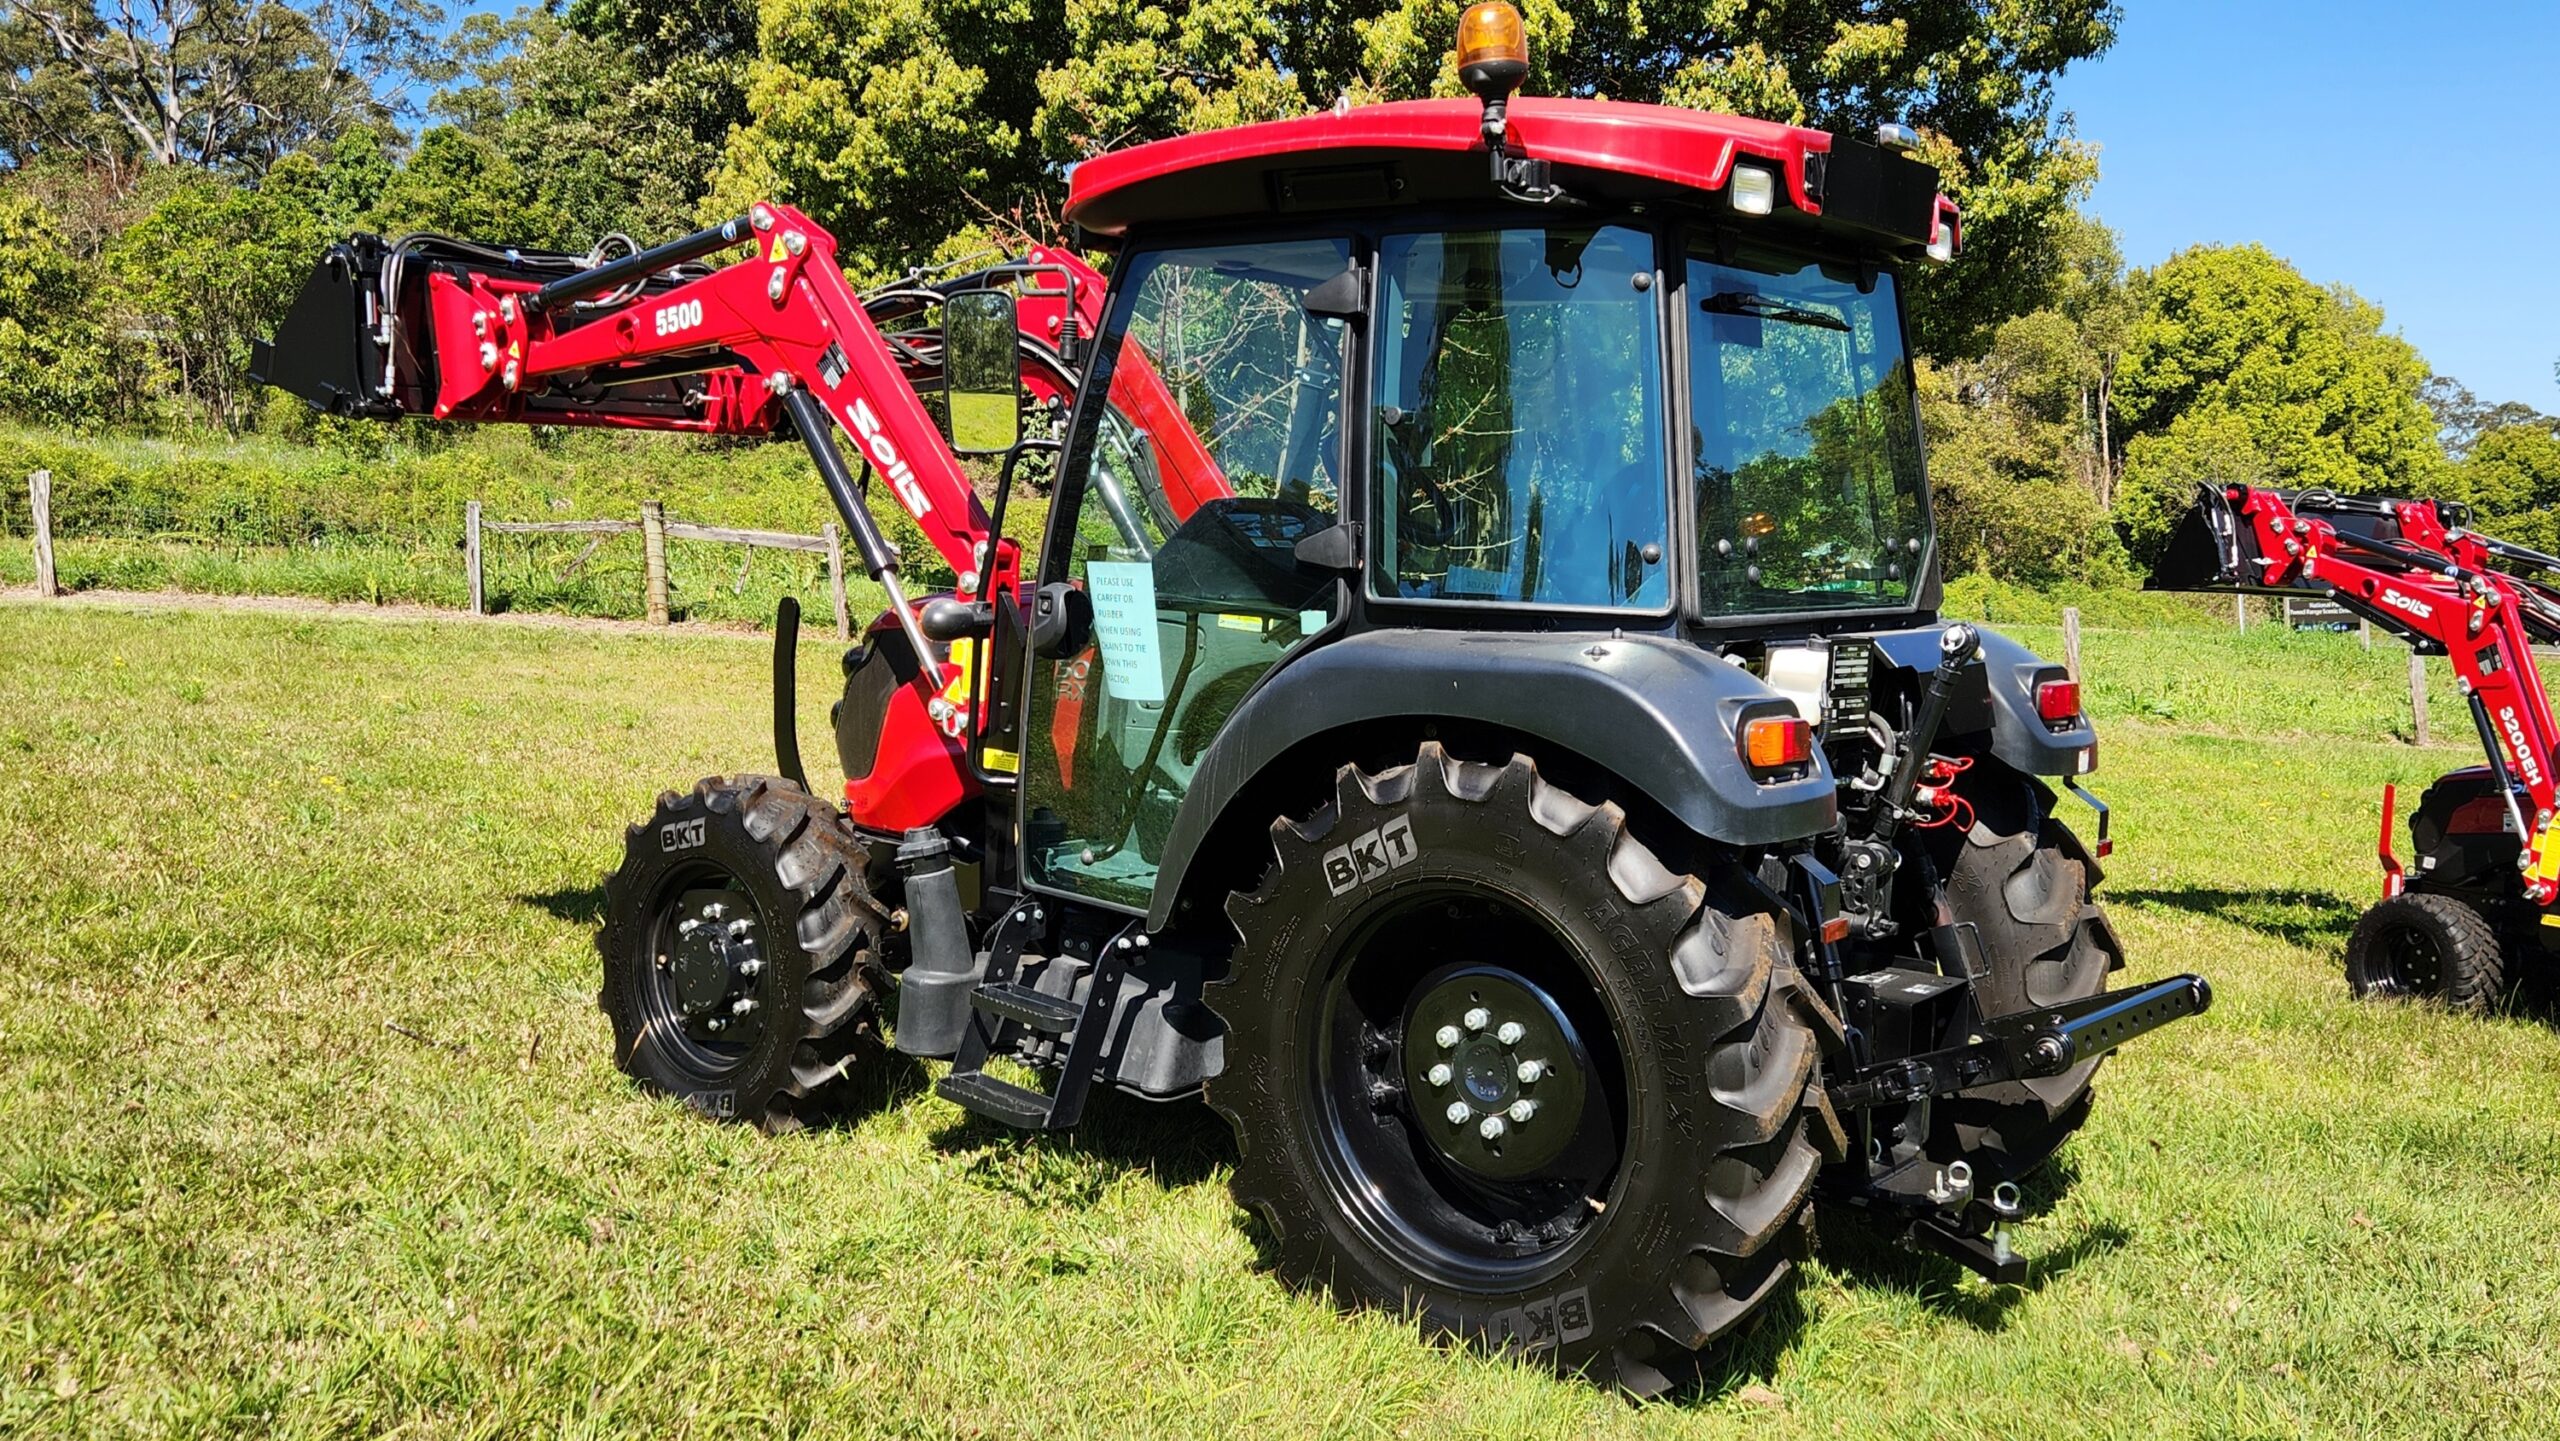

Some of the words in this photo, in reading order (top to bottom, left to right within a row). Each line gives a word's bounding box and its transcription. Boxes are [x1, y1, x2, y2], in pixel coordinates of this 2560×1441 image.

[655, 299, 702, 337] 5500
[1096, 576, 1120, 587] PLEASE
[1120, 577, 1134, 588] USE
[1096, 592, 1122, 603] CARPET
[1123, 594, 1134, 604] OR
[1097, 608, 1124, 619] RUBBER
[1099, 625, 1119, 636] WHEN
[1119, 626, 1142, 637] USING
[1101, 641, 1123, 652] CHAINS
[1123, 643, 1134, 652] TO
[1135, 643, 1147, 653] TIE
[1122, 658, 1138, 669] THIS
[2499, 705, 2543, 787] 3200EH
[661, 819, 705, 851] BKT
[1323, 817, 1415, 895] BKT
